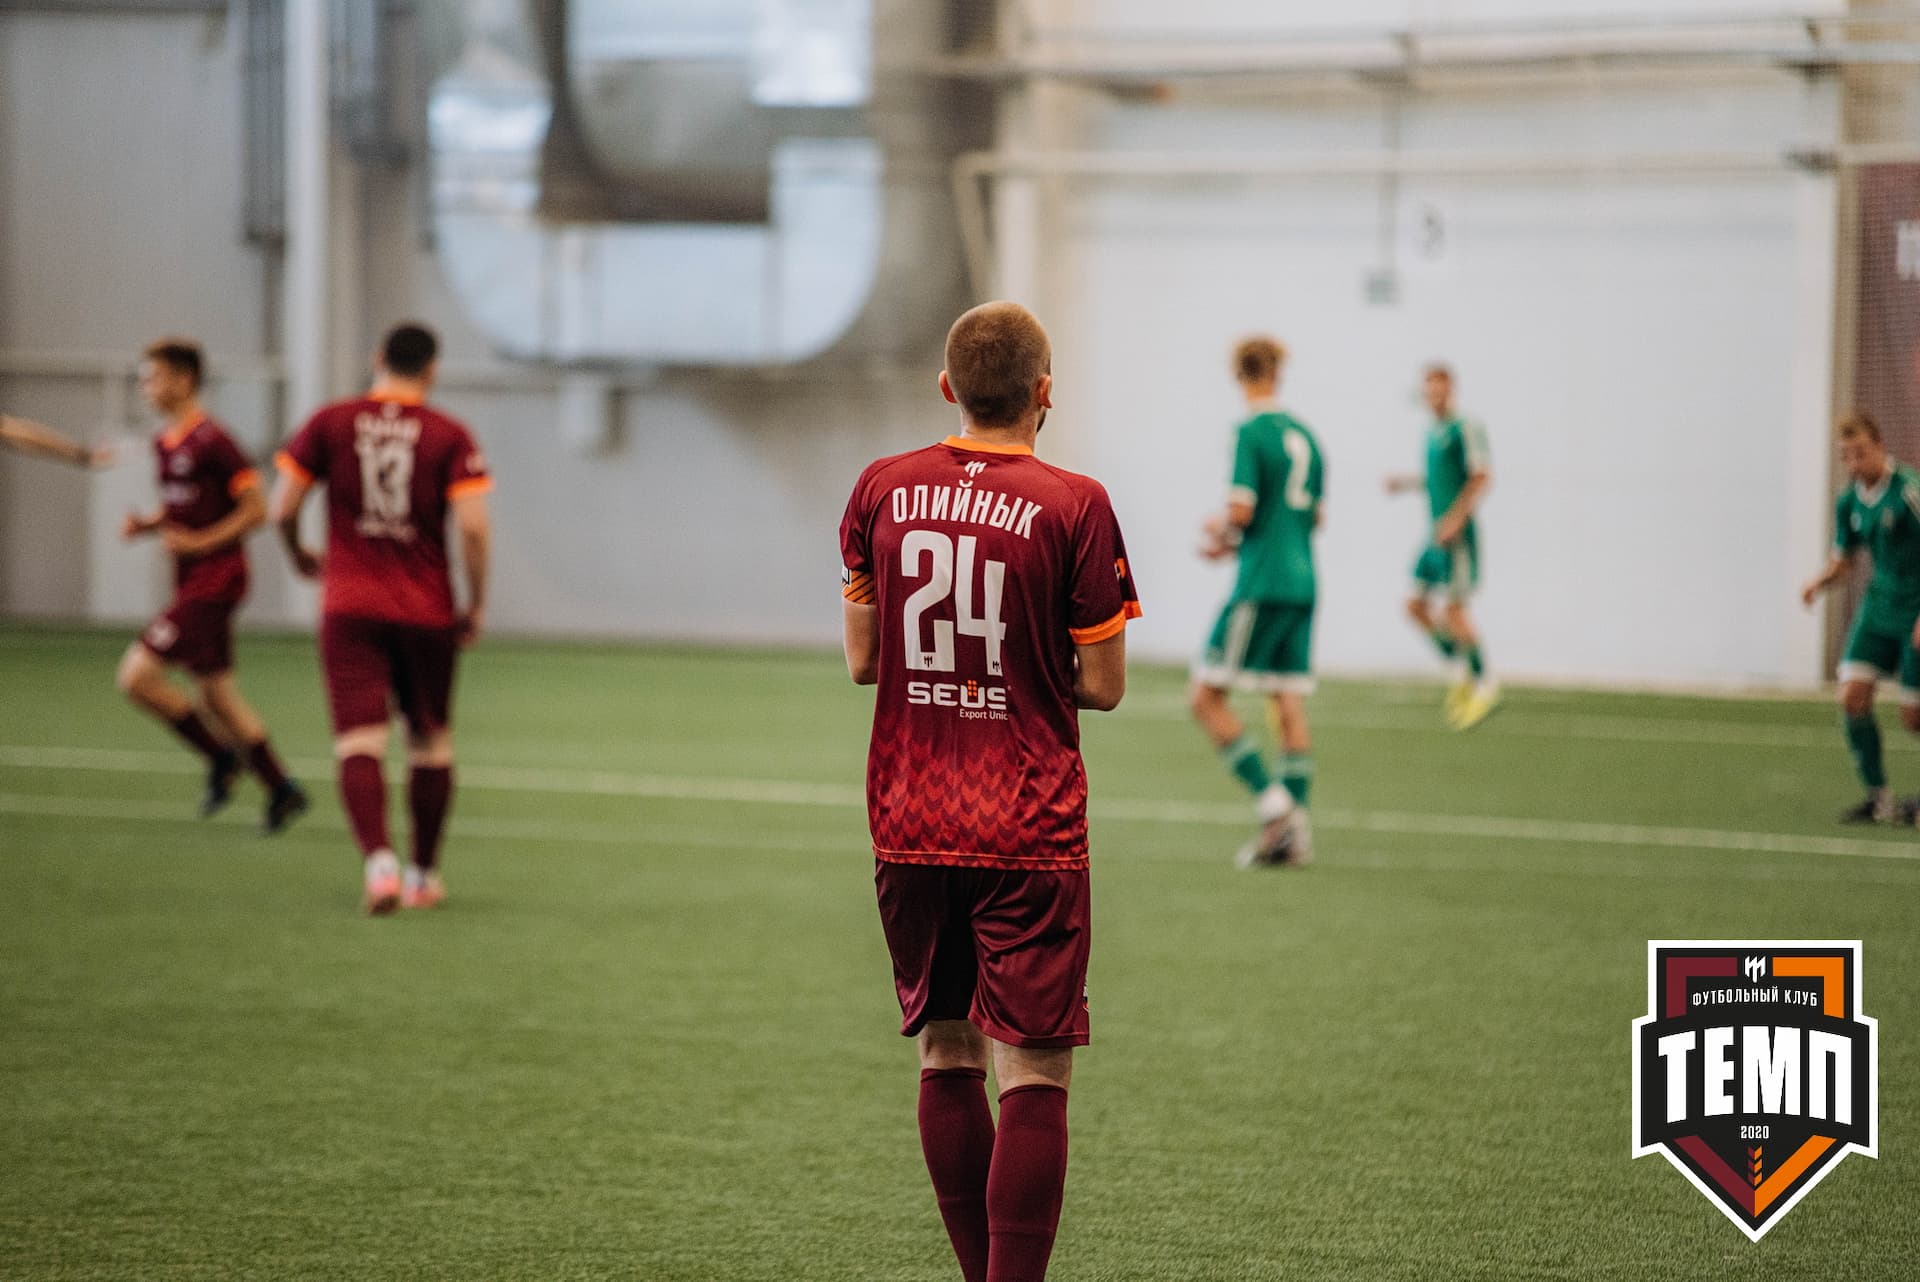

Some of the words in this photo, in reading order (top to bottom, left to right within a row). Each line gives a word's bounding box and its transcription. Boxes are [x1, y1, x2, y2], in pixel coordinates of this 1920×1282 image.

[892, 479, 1042, 539] ОЛИЙНЫК
[901, 530, 1006, 676] 24
[959, 708, 987, 720] Export
